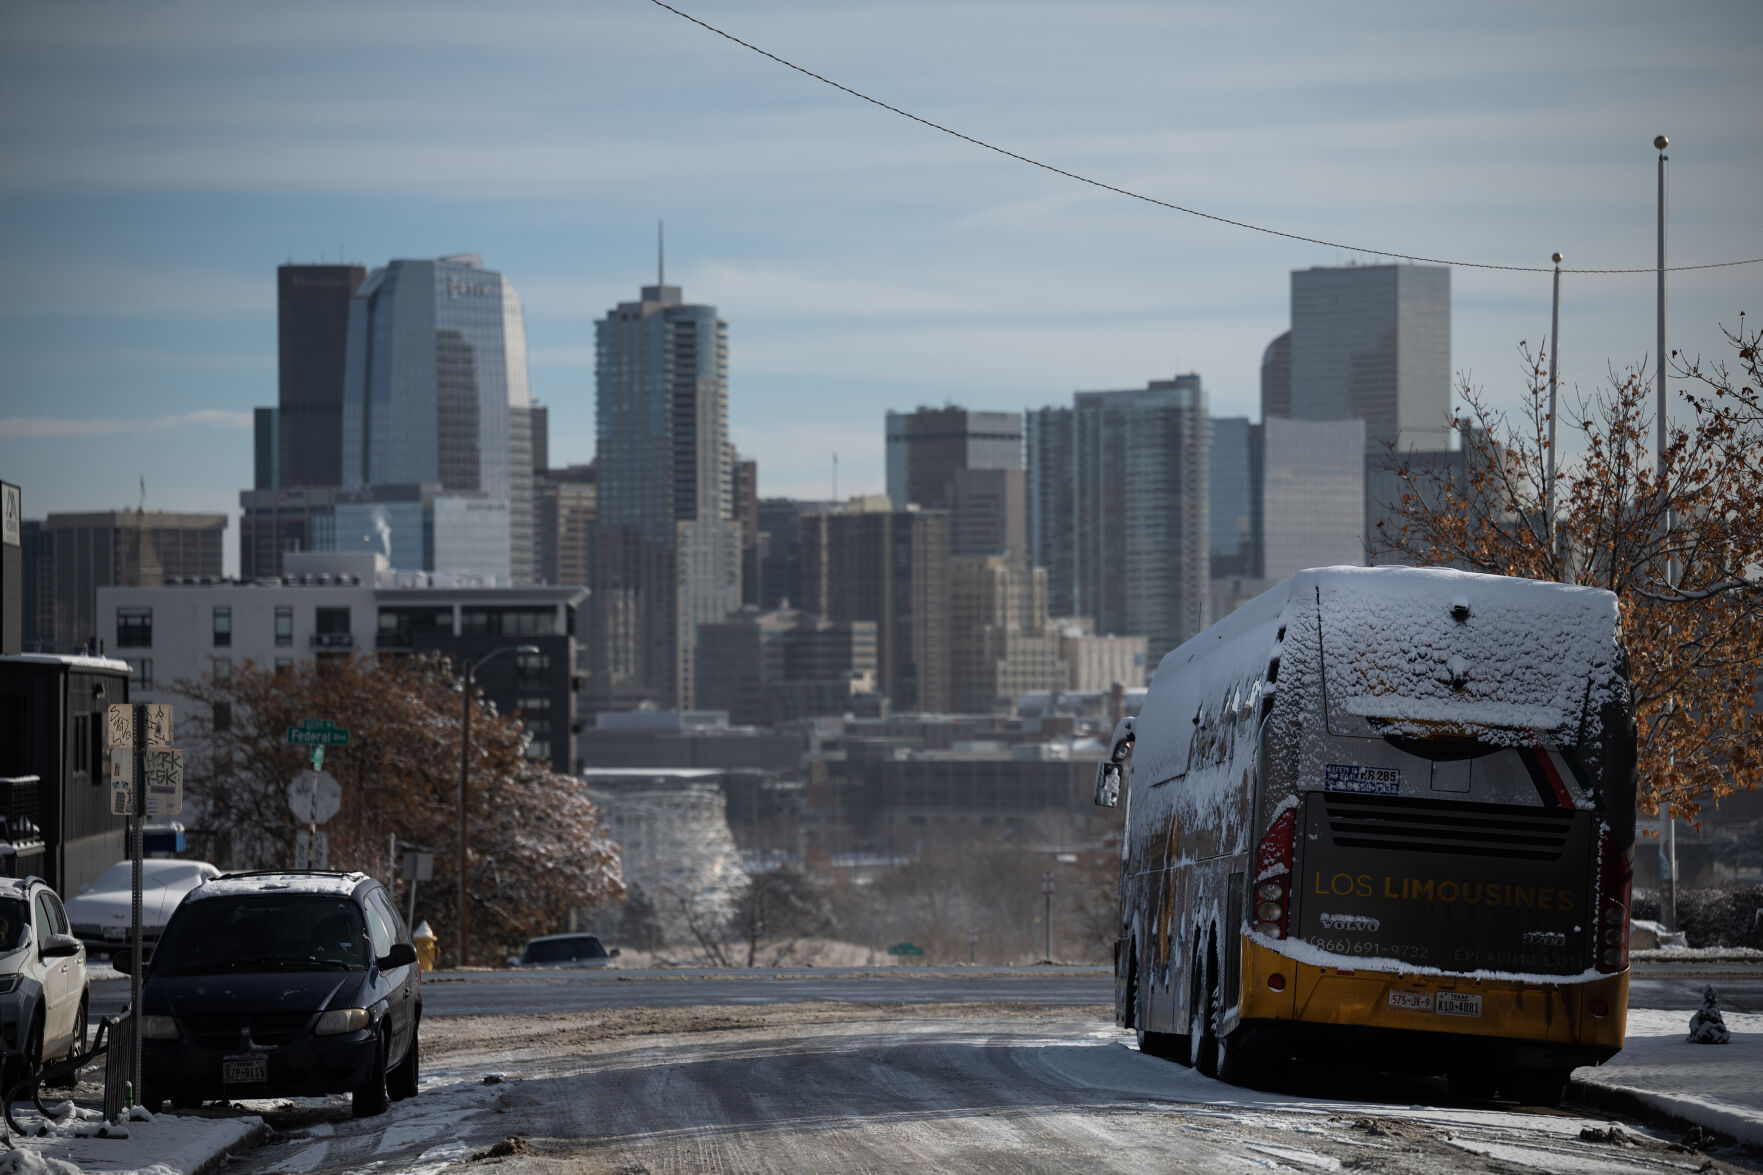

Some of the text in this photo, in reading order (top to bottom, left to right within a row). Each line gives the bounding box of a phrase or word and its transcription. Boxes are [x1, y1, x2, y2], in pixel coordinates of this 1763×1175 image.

[292, 729, 331, 743] Federal
[1315, 871, 1575, 911] LOS LIMOUSINES
[1321, 919, 1380, 932] VOLVO
[1392, 994, 1430, 1007] 575-JV-9
